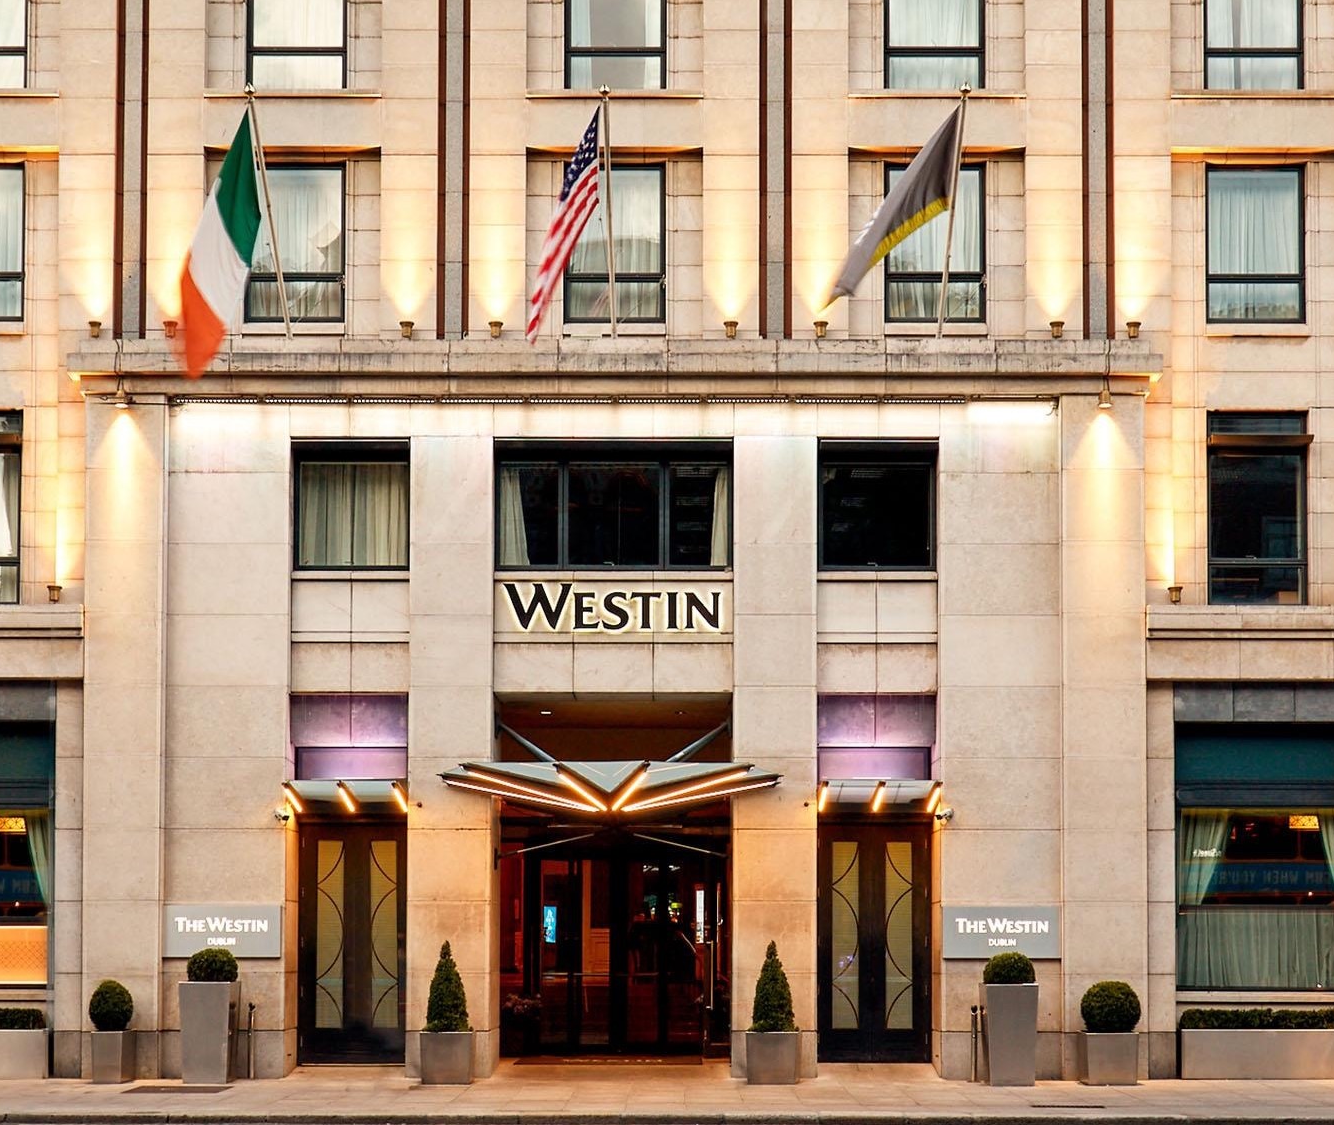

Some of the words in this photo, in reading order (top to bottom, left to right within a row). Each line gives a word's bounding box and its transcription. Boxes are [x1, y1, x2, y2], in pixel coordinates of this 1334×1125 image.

[503, 583, 721, 630] WESTIN
[174, 917, 207, 933] THE
[206, 917, 268, 933] WESTIN
[955, 918, 988, 934] THE
[986, 918, 1049, 934] WESTIN
[207, 937, 236, 946] DUBLIN
[988, 938, 1017, 947] DUBLIN
